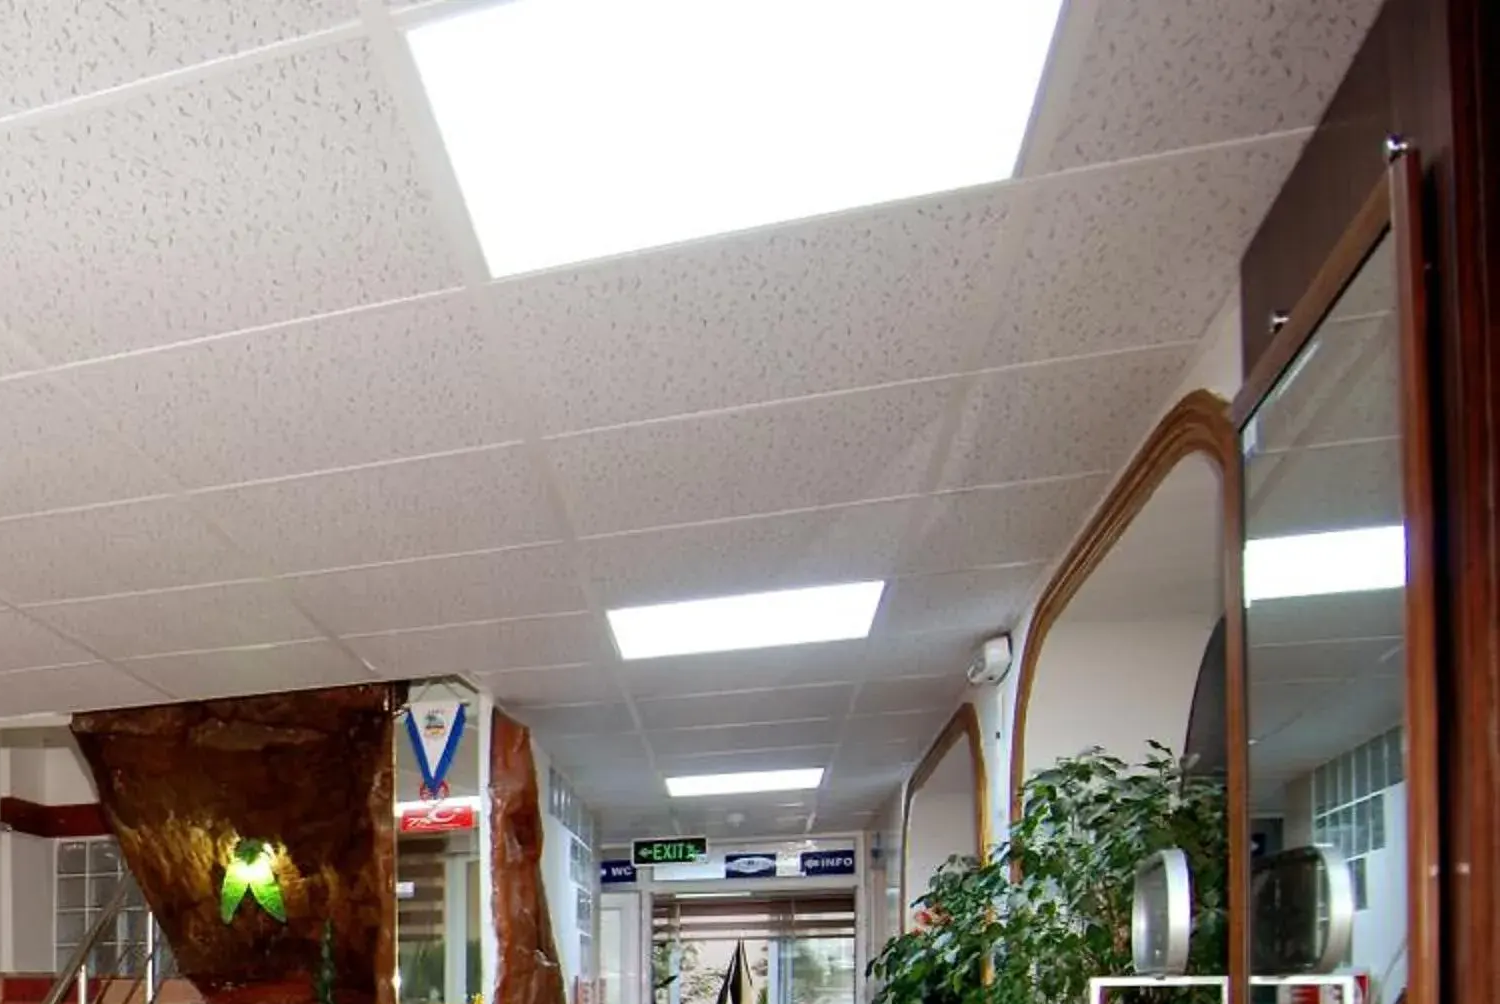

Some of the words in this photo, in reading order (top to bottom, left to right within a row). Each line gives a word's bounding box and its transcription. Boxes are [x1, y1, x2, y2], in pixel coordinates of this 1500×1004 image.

[652, 843, 684, 861] EXIT
[821, 858, 853, 868] INFO
[611, 866, 633, 877] WC
